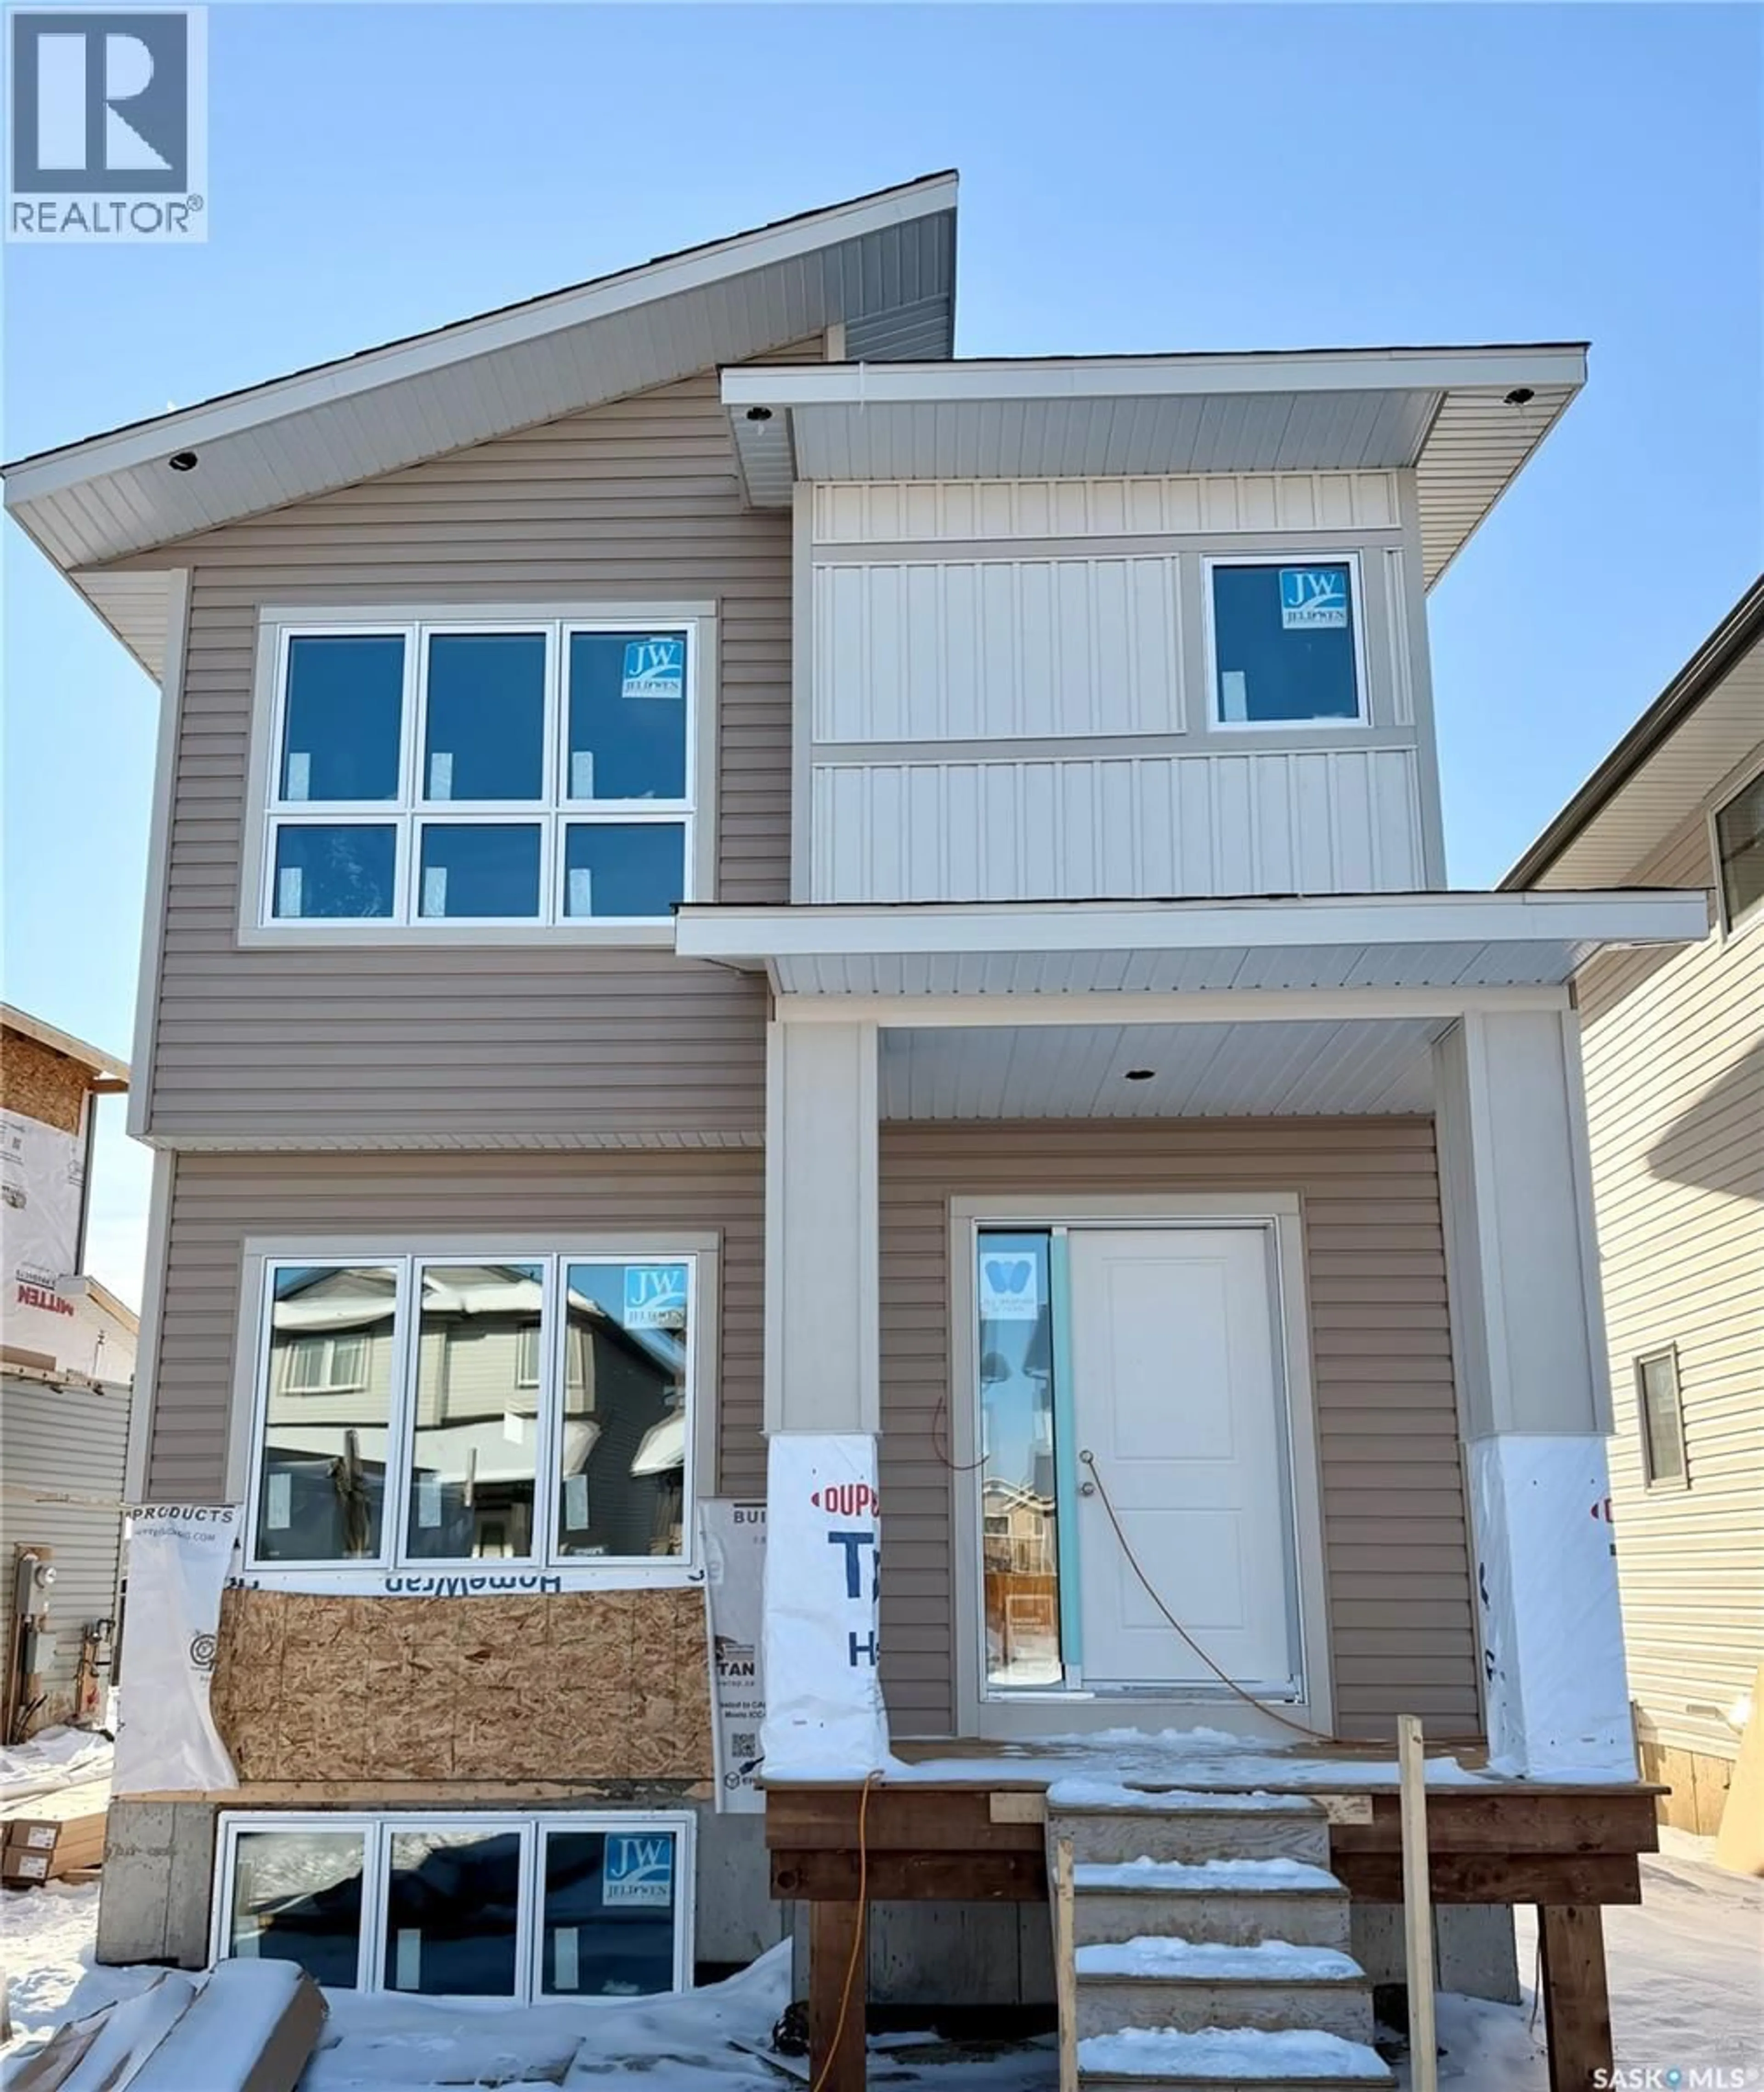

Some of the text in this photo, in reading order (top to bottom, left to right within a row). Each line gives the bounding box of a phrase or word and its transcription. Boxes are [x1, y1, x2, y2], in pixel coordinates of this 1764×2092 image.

[1288, 573, 1337, 606] JW
[629, 645, 678, 675] JW
[18, 1285, 74, 1317] MITTEN
[630, 1270, 680, 1304] JW
[132, 1506, 233, 1523] PRODUCTS
[611, 1839, 666, 1877] JW
